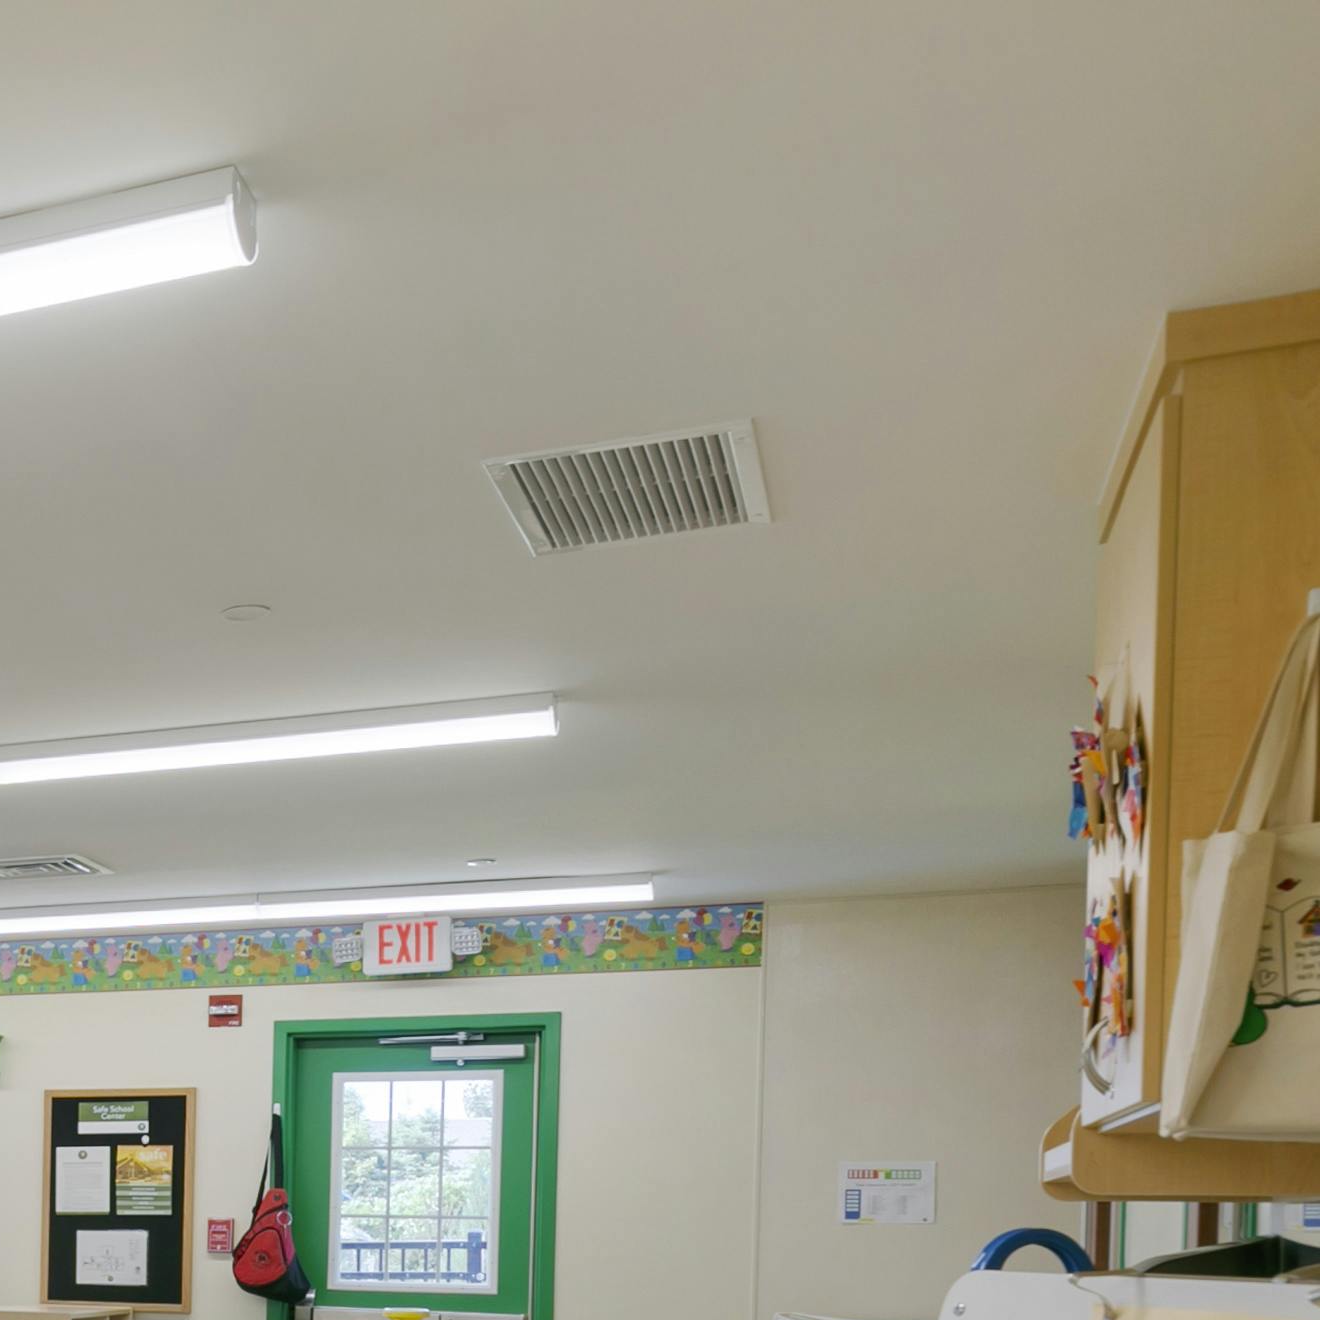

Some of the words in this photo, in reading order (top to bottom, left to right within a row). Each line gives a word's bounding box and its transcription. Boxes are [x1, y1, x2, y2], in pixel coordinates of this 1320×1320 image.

[378, 920, 438, 965] EXIT
[92, 1105, 109, 1114] Safe
[110, 1105, 135, 1113] School
[101, 1112, 126, 1120] Center
